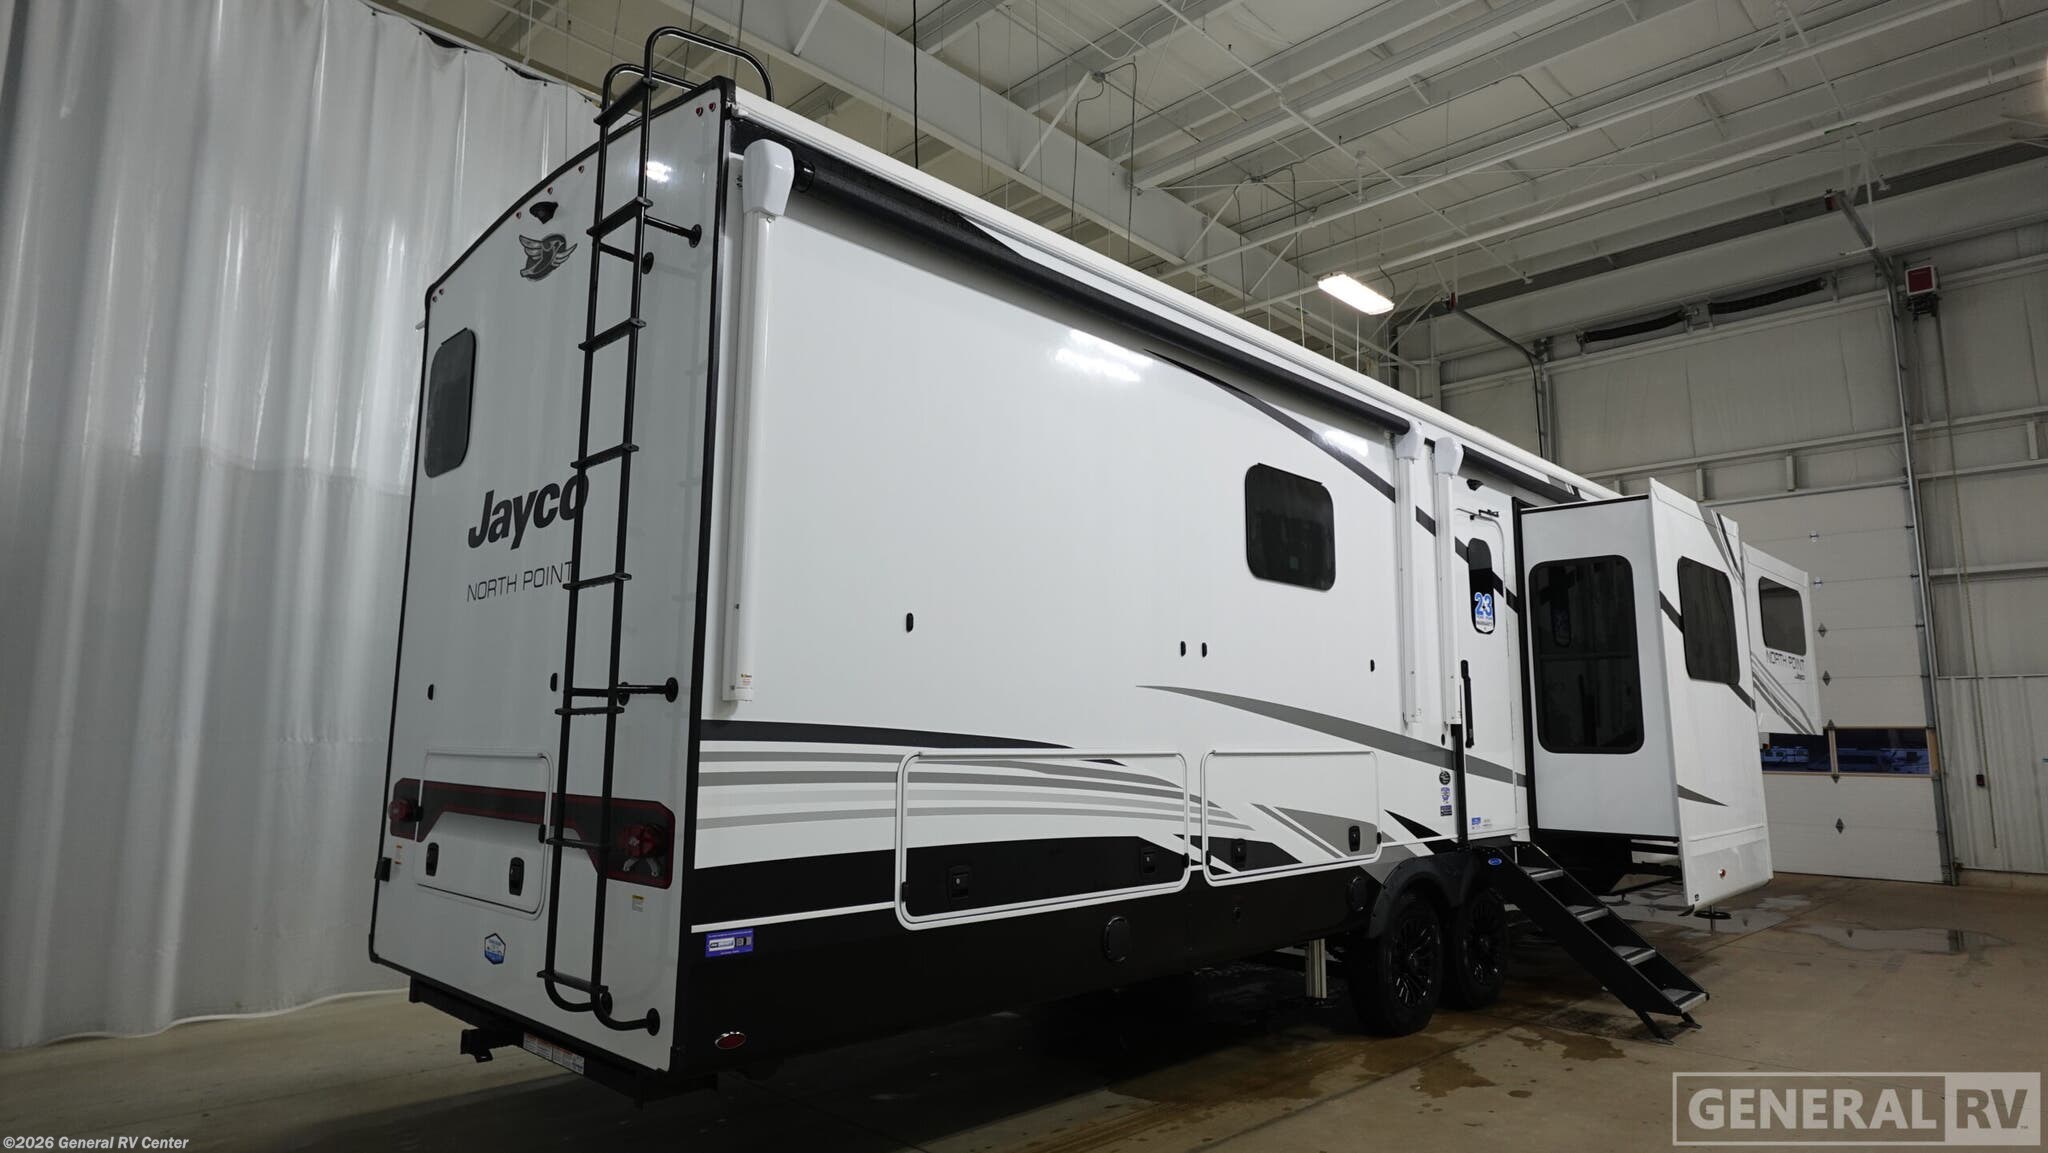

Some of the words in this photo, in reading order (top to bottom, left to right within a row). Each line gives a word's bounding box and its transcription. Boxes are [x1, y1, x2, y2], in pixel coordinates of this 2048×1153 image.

[468, 474, 589, 550] Jayco
[467, 574, 518, 602] NORTH
[523, 561, 573, 590] POINT
